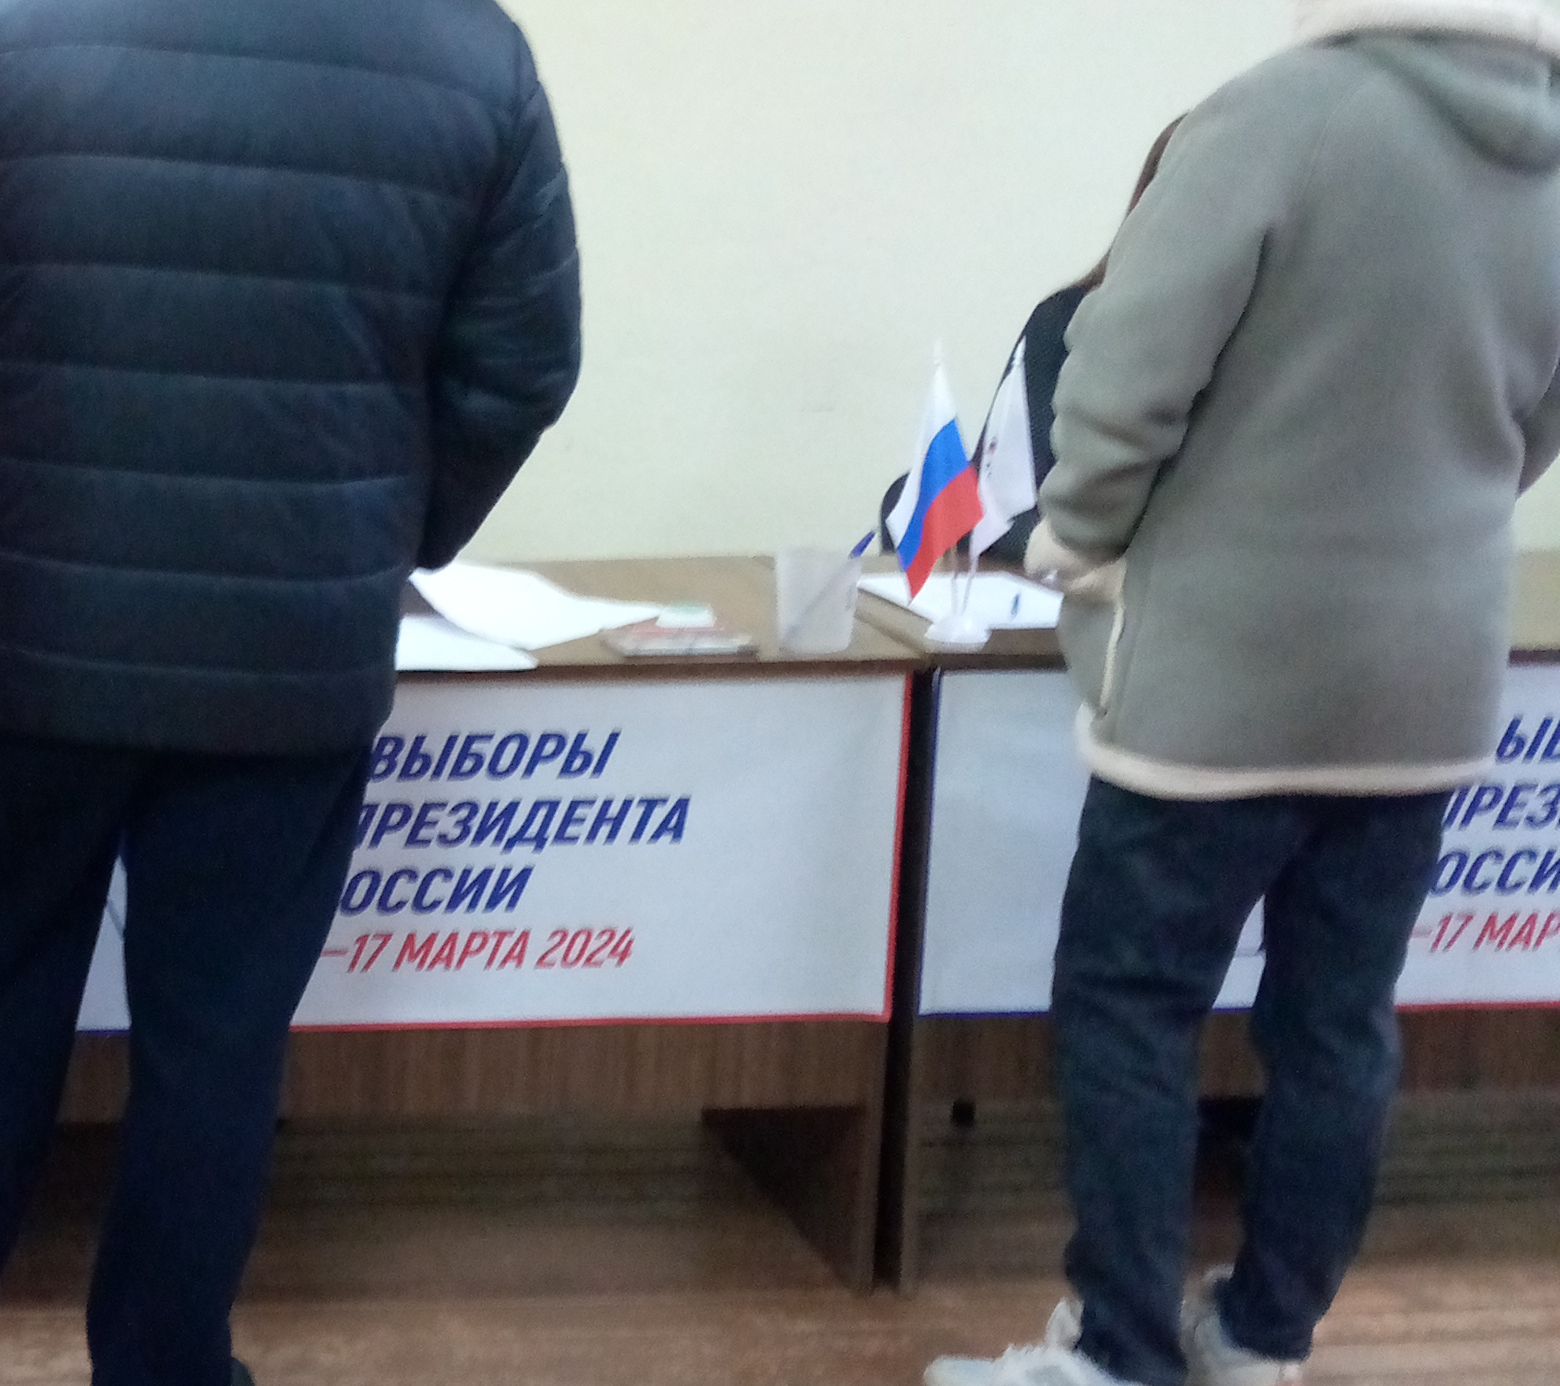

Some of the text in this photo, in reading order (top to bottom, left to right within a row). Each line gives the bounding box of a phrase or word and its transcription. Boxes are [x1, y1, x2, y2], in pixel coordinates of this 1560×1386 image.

[369, 728, 621, 783] ВЫБОРЫ
[340, 864, 536, 918] ОССИИ
[1430, 847, 1560, 896] ОССИ
[392, 929, 532, 972] МАРТА
[536, 927, 635, 970] 2024
